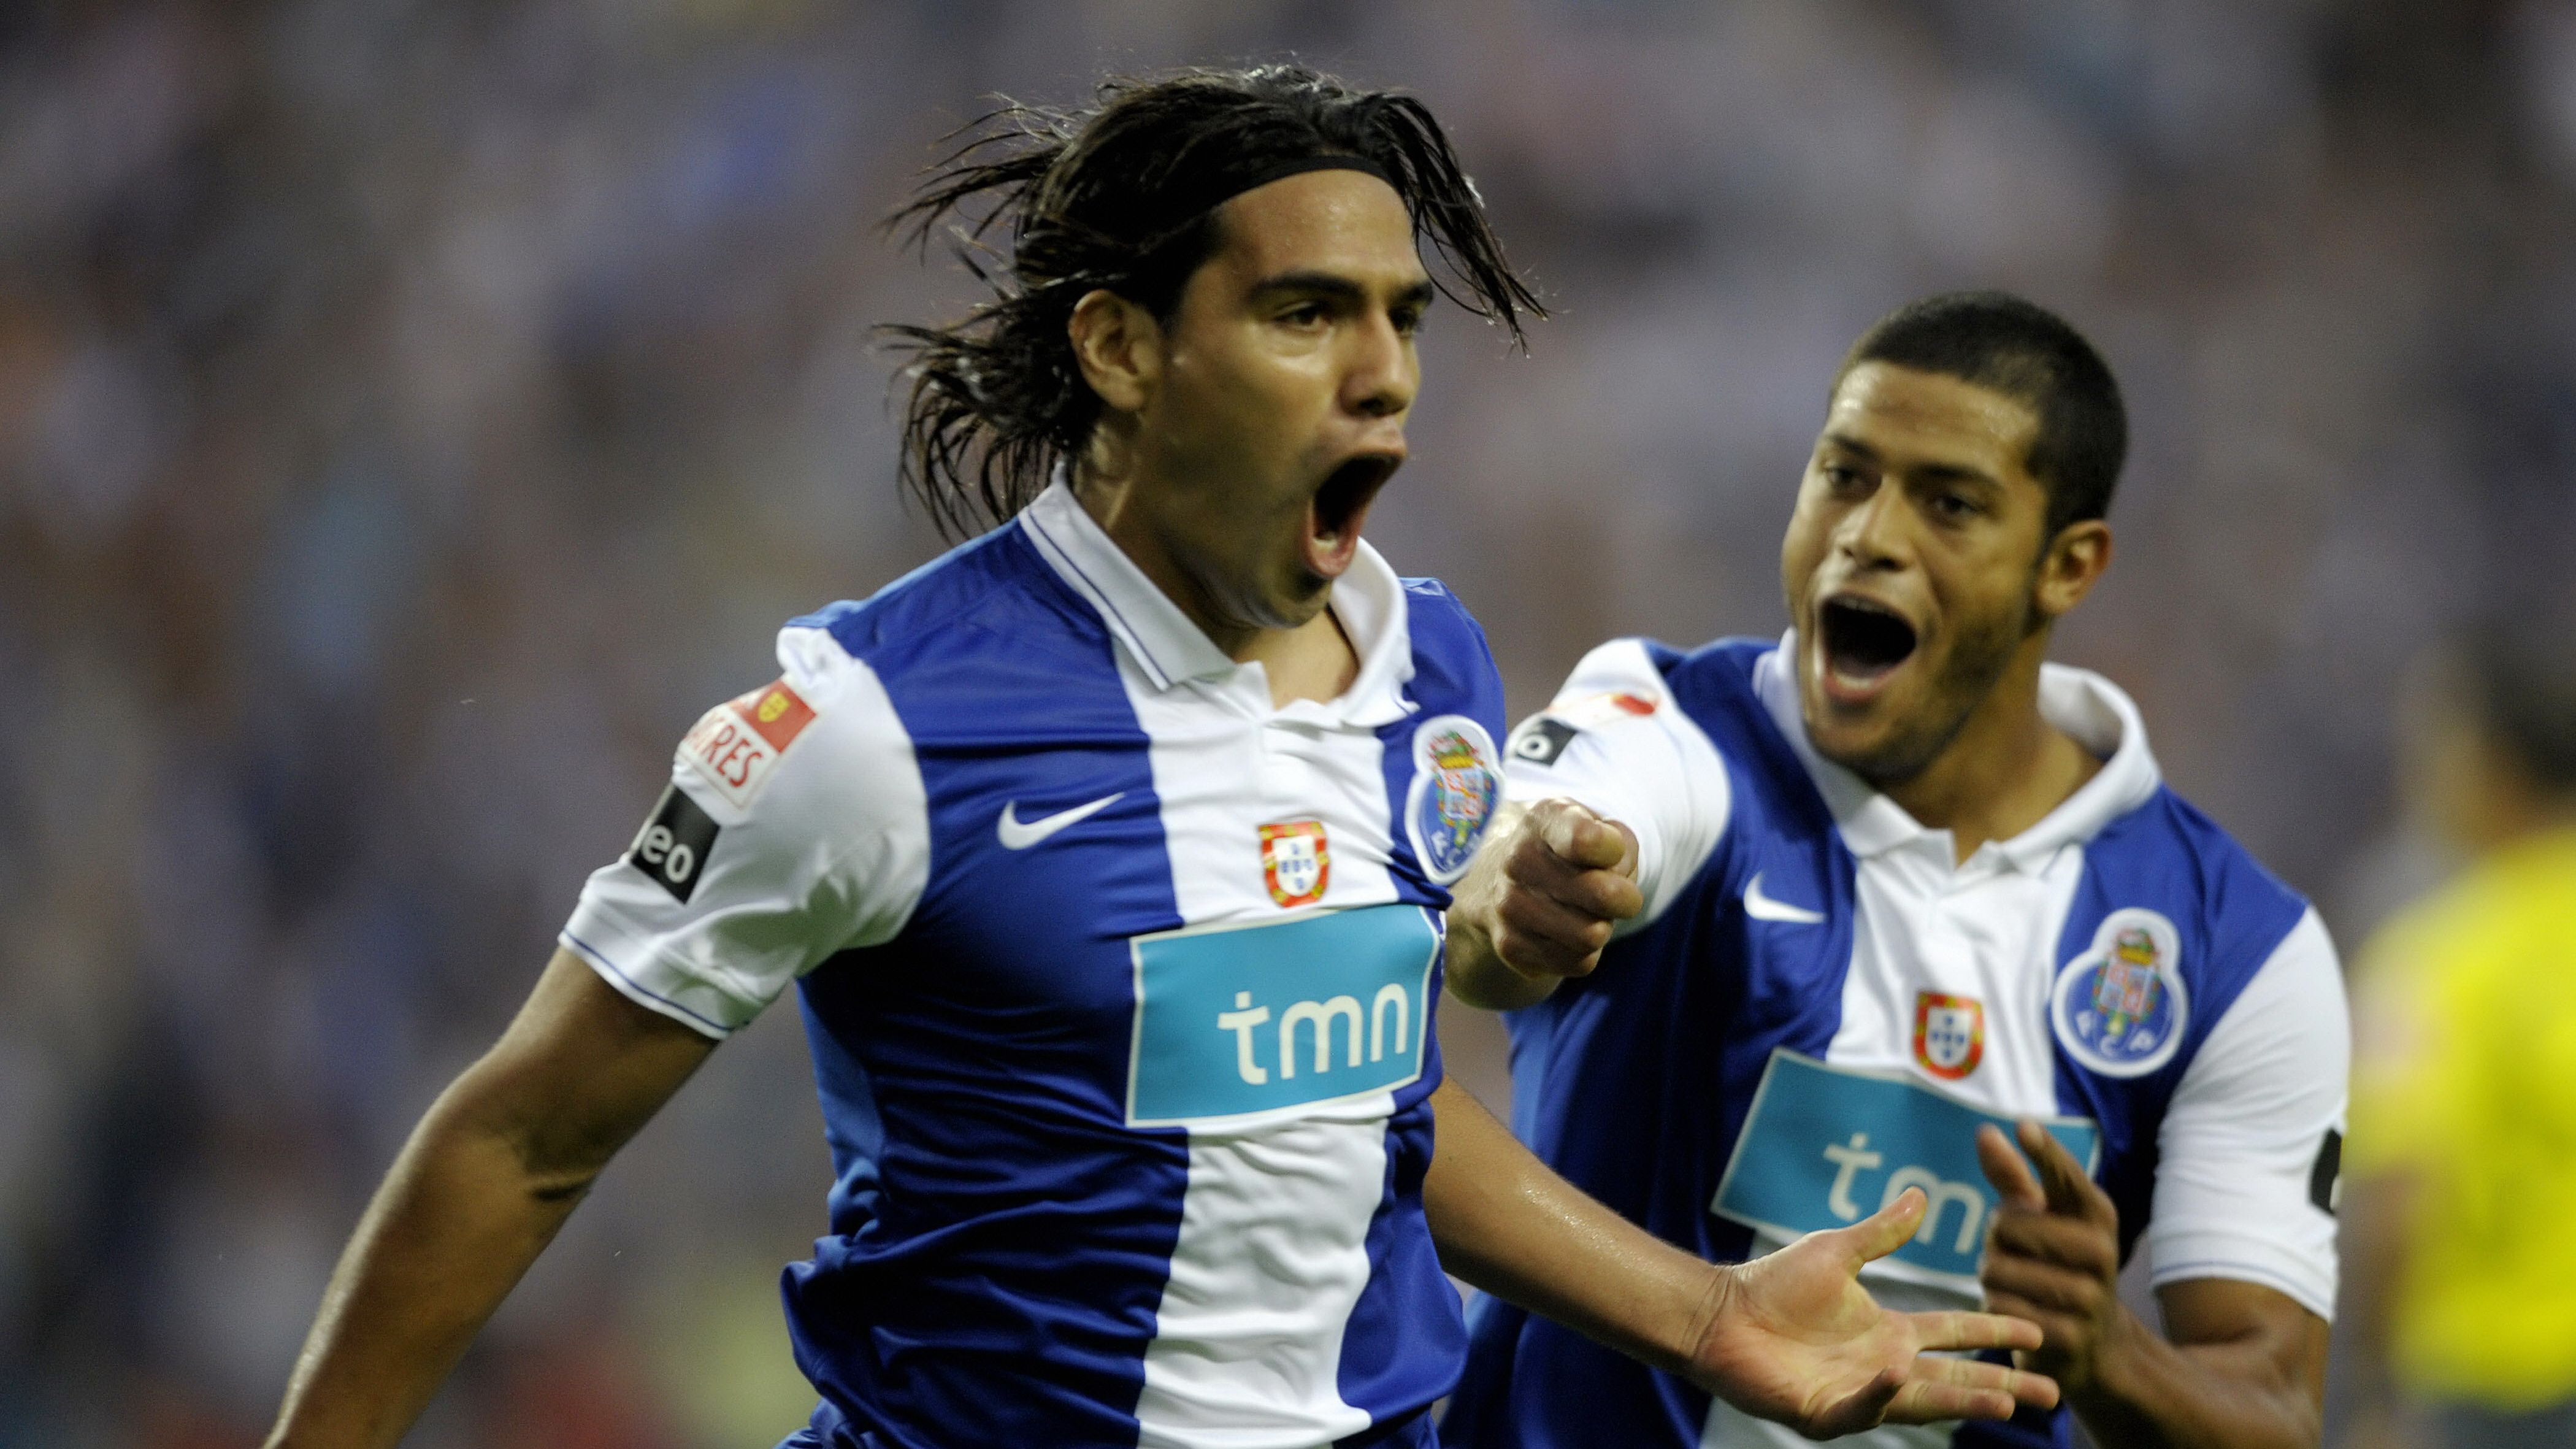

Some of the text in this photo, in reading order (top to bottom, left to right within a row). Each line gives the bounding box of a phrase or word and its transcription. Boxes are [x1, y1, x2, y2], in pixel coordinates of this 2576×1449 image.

[684, 712, 764, 788] RES
[642, 824, 694, 883] eo
[1217, 982, 1409, 1085] tmn
[1823, 1132, 1986, 1254] tm
